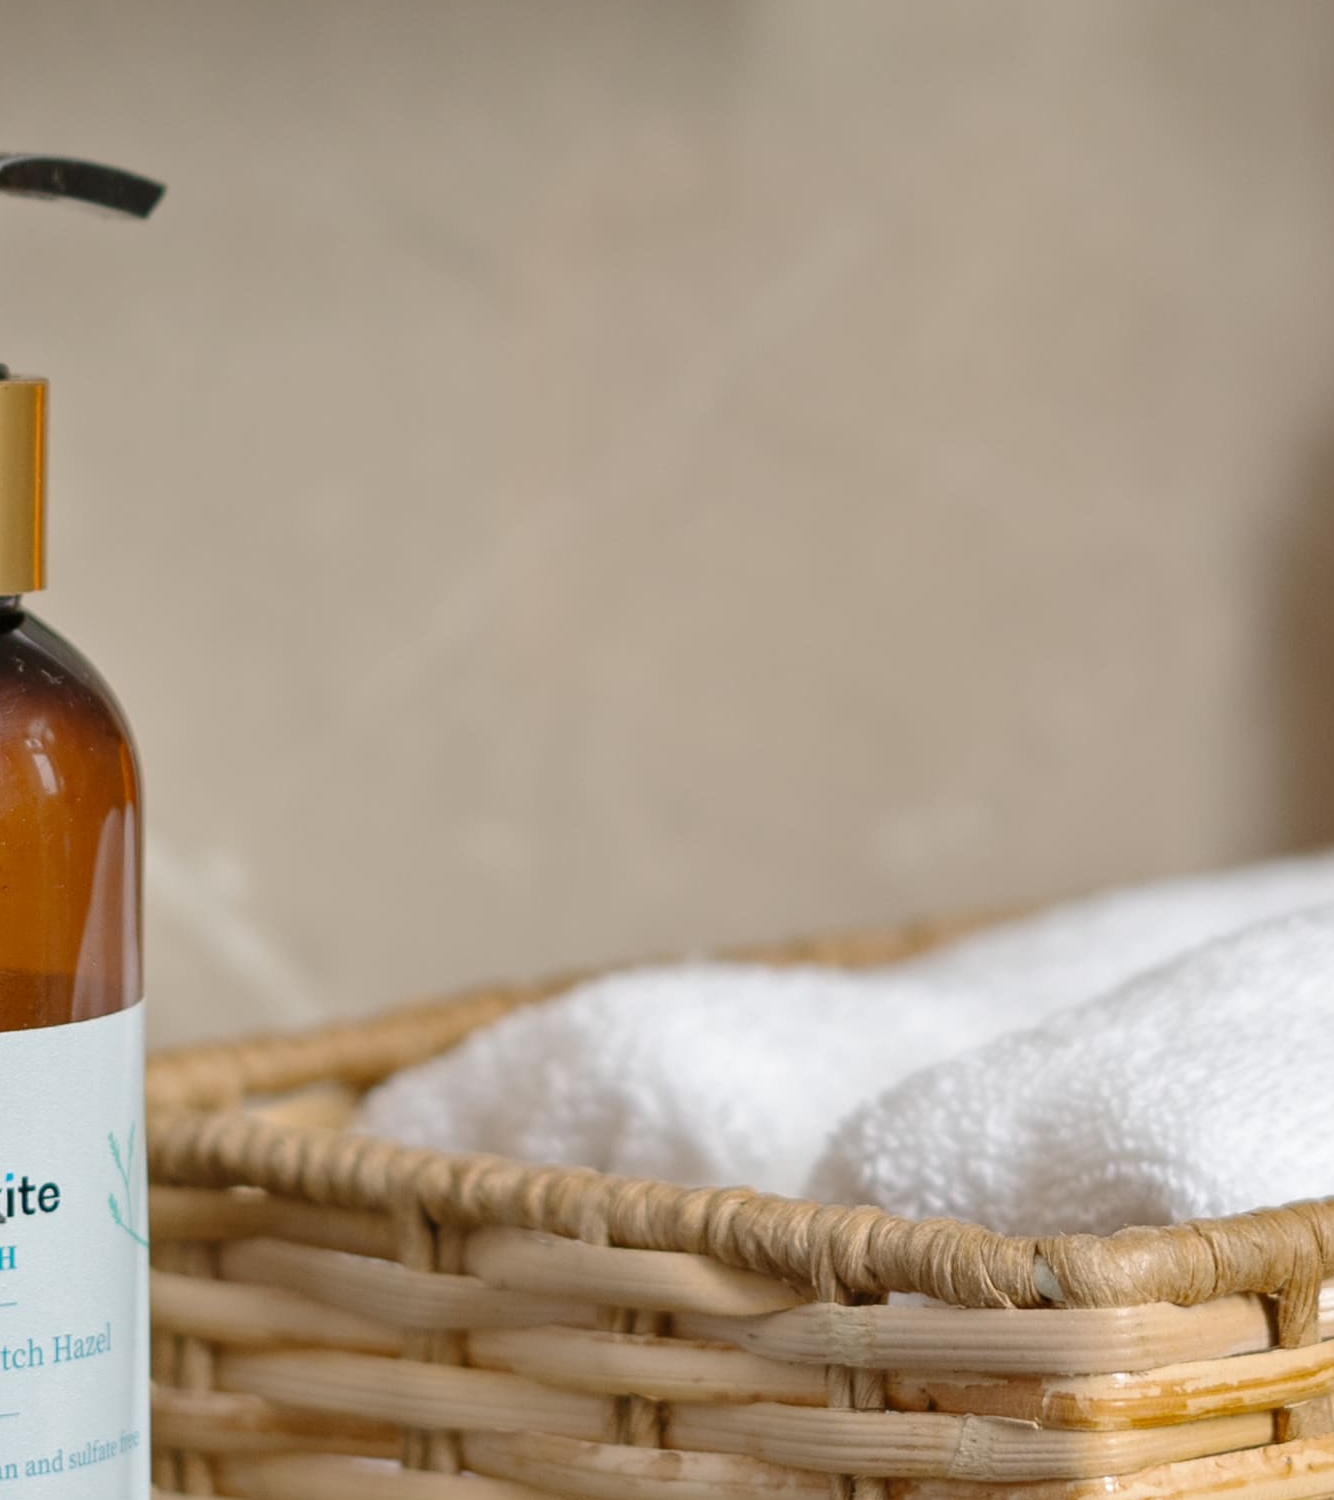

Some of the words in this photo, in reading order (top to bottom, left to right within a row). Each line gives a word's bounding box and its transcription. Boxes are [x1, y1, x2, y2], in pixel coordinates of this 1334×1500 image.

[52, 1323, 113, 1363] Hazel
[25, 1449, 63, 1478] and
[69, 1436, 118, 1471] sulfate
